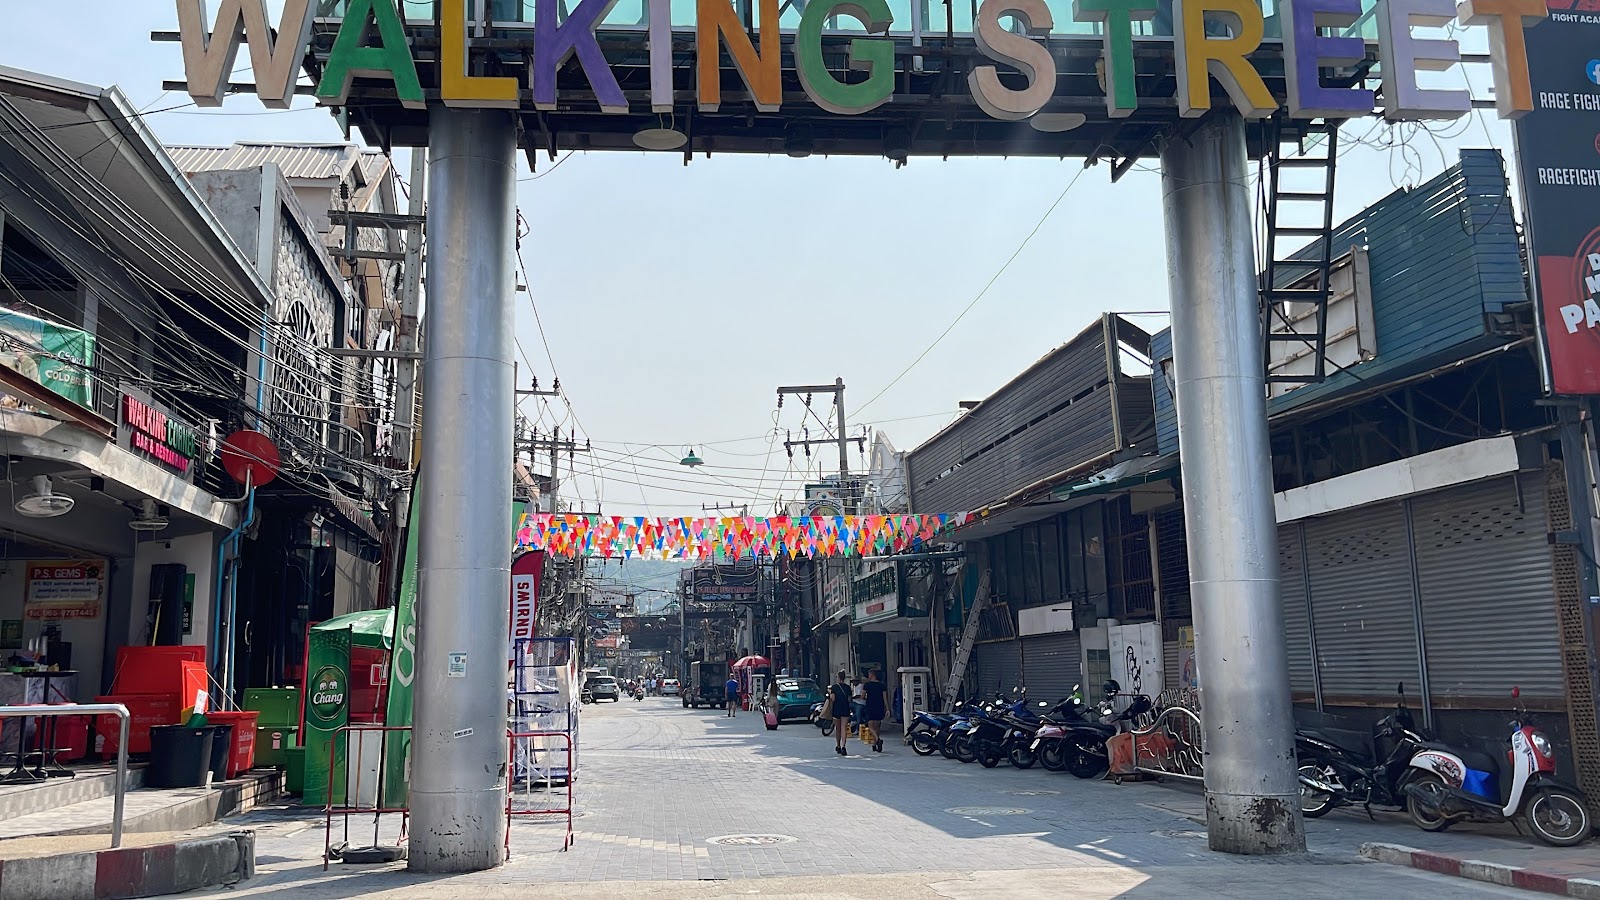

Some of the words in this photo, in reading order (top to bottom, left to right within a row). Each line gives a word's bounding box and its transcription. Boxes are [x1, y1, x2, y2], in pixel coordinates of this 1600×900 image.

[1552, 13, 1578, 23] FIGHT
[1580, 15, 1600, 24] ACA
[177, 0, 895, 113] WALKING
[967, 0, 1549, 121] STREET
[1540, 92, 1571, 109] RAGE
[1573, 93, 1600, 111] FIGH
[44, 369, 70, 382] COLD
[128, 395, 167, 442] WALKING
[136, 431, 149, 451] BAR
[149, 438, 157, 454] &
[155, 442, 189, 472] RESTAURANT
[34, 568, 51, 579] P.S.
[54, 568, 81, 579] GEMS
[313, 692, 343, 705] Chang
